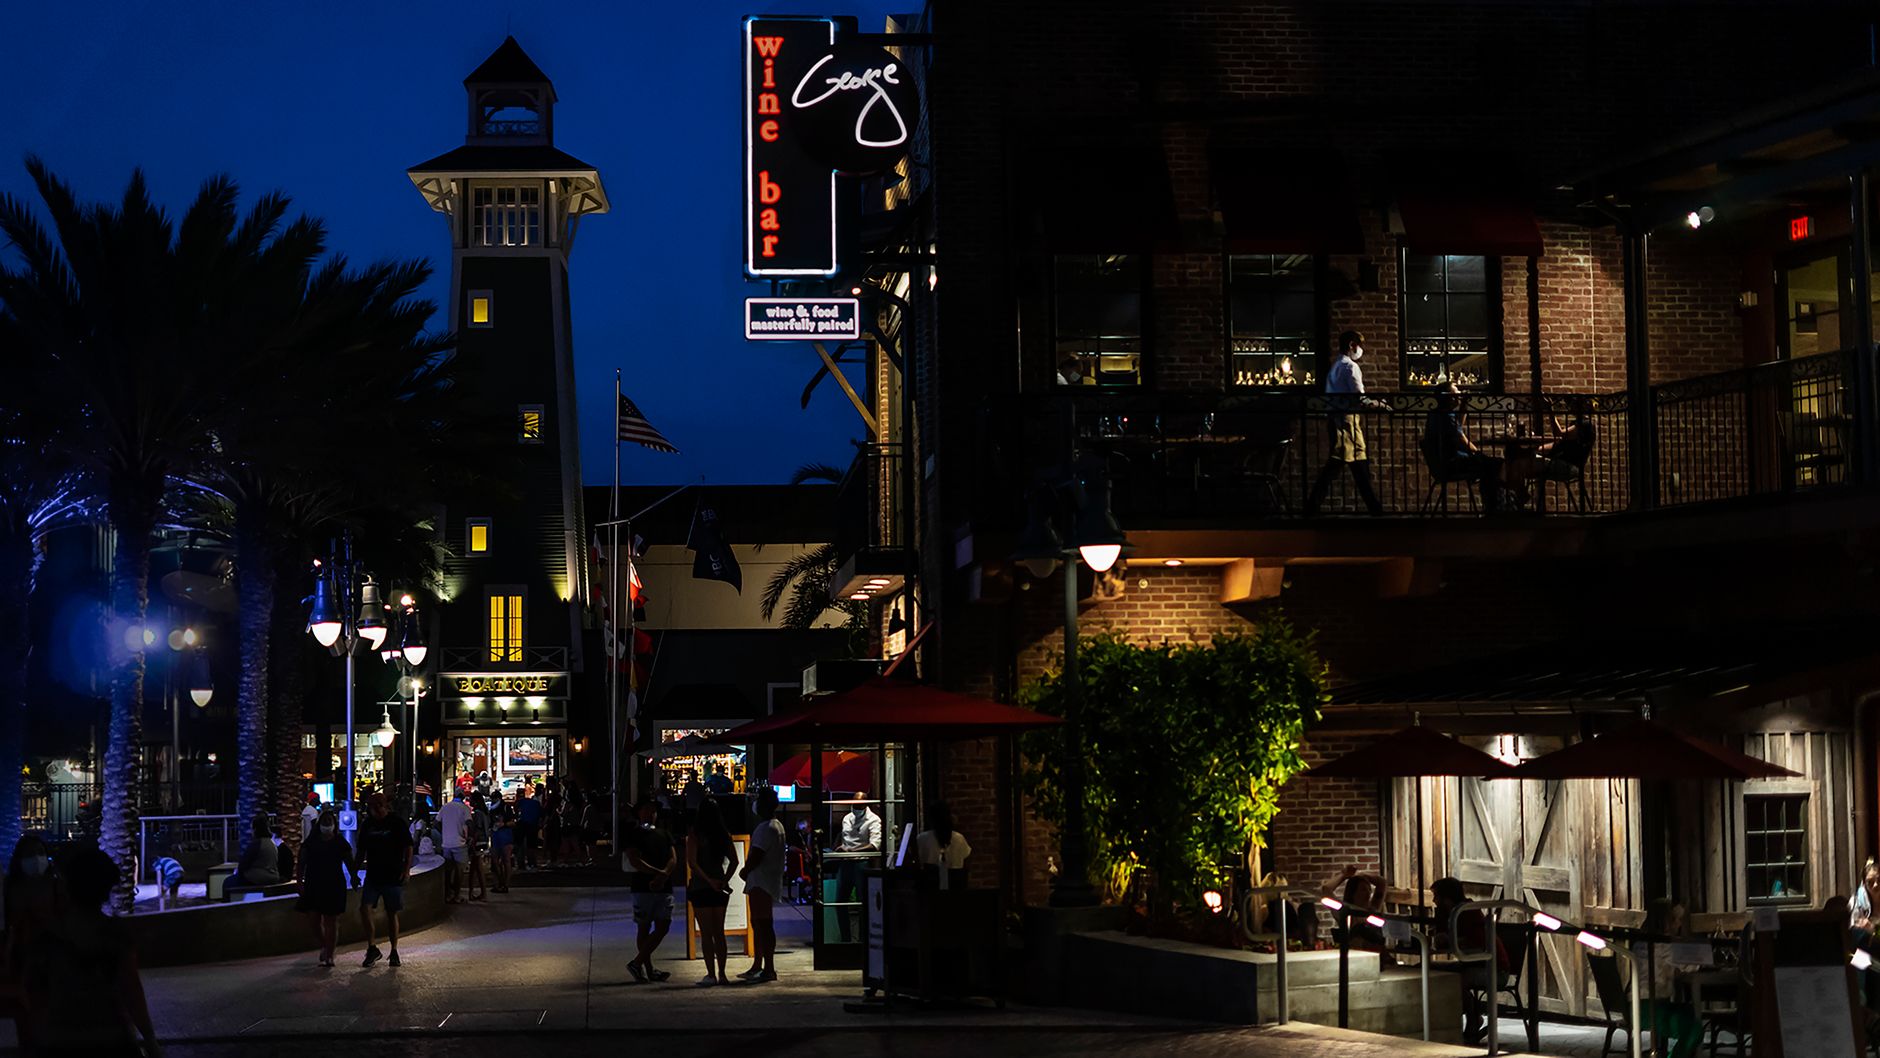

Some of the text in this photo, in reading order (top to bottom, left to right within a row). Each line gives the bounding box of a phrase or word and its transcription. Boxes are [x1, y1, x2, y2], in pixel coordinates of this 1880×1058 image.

[791, 53, 908, 147] George
[753, 36, 785, 258] wine bar
[1791, 216, 1809, 240] EXIT
[765, 304, 839, 318] wine & food
[751, 318, 854, 332] masterfully paired
[458, 679, 549, 694] BOATIQUE
